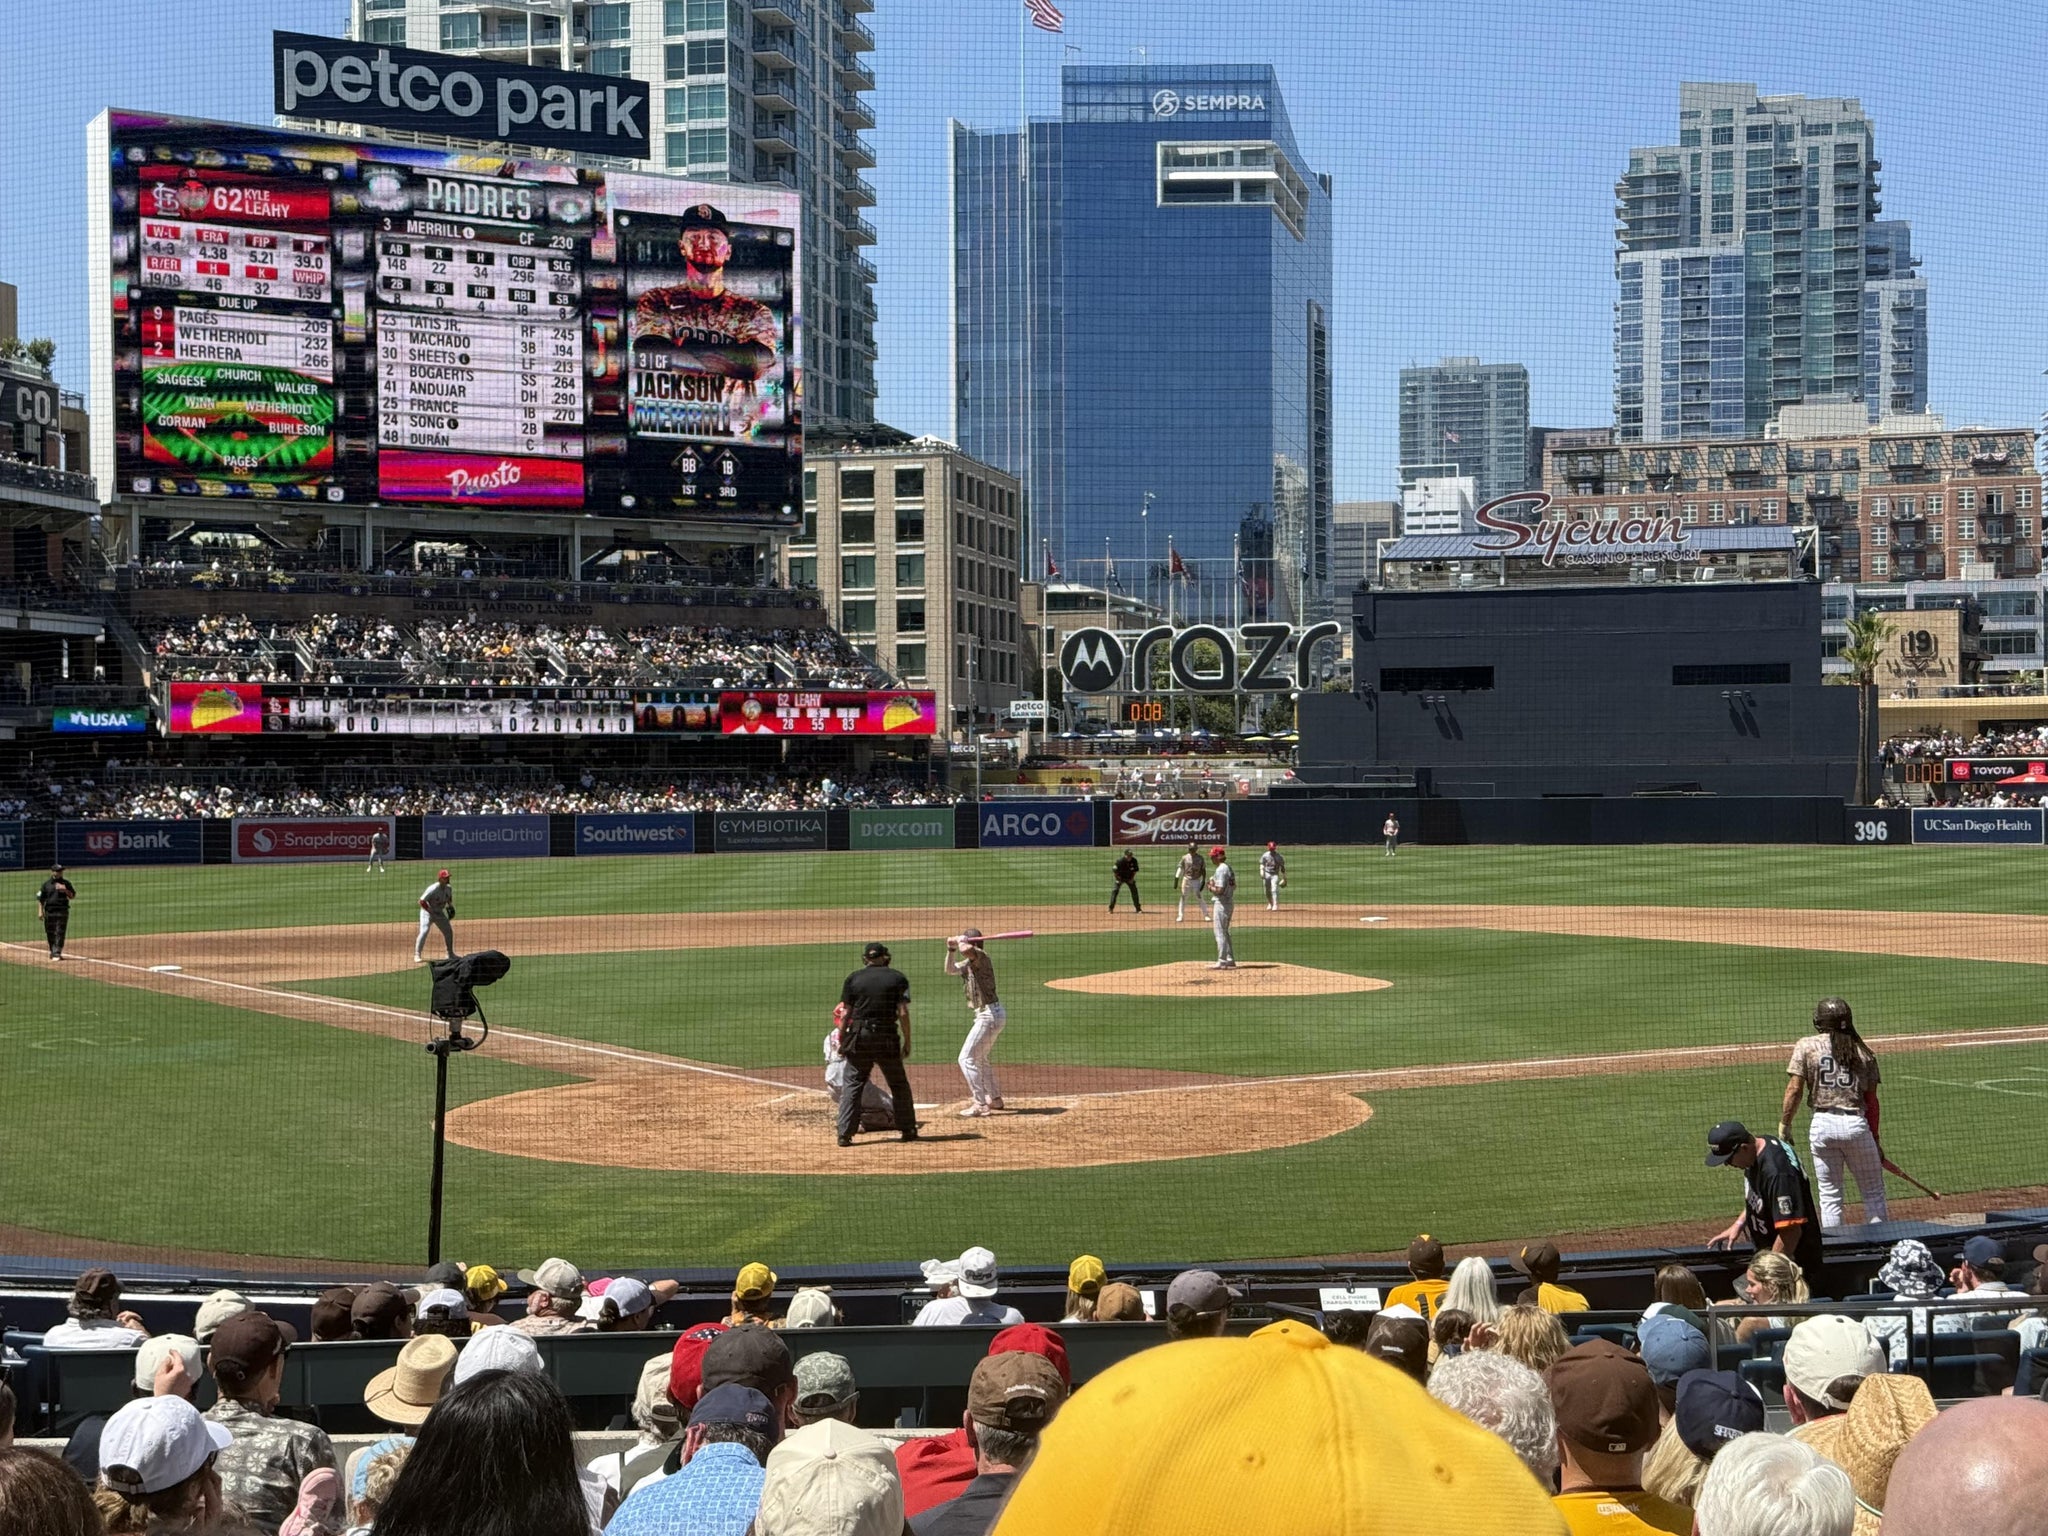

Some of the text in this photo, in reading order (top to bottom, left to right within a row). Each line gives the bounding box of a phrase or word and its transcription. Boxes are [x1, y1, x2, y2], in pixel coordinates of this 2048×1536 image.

[283, 49, 644, 139] petco park
[1184, 94, 1266, 111] SEMPRA
[213, 187, 243, 212] 62
[244, 188, 270, 201] KYLE
[427, 177, 532, 220] PADRES
[244, 200, 290, 218] LEAHY
[152, 226, 314, 252] W-L ERA FIP IP
[383, 217, 574, 250] 3 MERRILL CF .230
[199, 246, 228, 260] 4.38
[250, 251, 274, 264] 5.21
[294, 256, 323, 269] 39.0
[389, 244, 571, 272] AB R H OBP SLG
[150, 258, 323, 284] R/ER H K WHIP
[387, 257, 407, 271] 148
[432, 262, 447, 275] 22
[473, 266, 488, 279] 34
[509, 270, 535, 284] .296
[149, 272, 180, 287] 19/19
[205, 277, 222, 291] 46
[254, 282, 270, 295] 32
[390, 278, 569, 305] 2B 3B HR RBI SB
[218, 296, 258, 310] DUE UP
[436, 297, 444, 310] 0
[477, 301, 485, 313] 4
[516, 304, 529, 316] 18
[559, 307, 566, 320] 8
[153, 306, 328, 334] 9 PAGÉS .209
[381, 314, 575, 342] 23 TATIS JR. RF .245
[155, 324, 328, 350] 1 WETHERHOLT .232
[384, 331, 574, 357] 13 MACHADO 3B .194
[154, 342, 329, 367] 2 HERRERA .266
[382, 347, 574, 373] 30 SHEETS LF .213
[639, 353, 669, 369] 3 CF
[157, 374, 207, 388] SAGGESE
[216, 368, 262, 382] CHURCH
[386, 364, 575, 389] 2 BOGAERTS SS .264
[274, 381, 318, 395] WALKER
[383, 381, 576, 406] 41 ANDUJAR DH .290
[634, 372, 726, 403] JACKSON
[16, 386, 58, 427] CO.
[184, 395, 216, 410] WINN
[244, 401, 314, 415] WETHERHOLT
[383, 397, 575, 421] 25 FRANCE 1B .270
[158, 415, 206, 428] GORMAN
[269, 422, 325, 436] BURLESON
[383, 414, 537, 435] 24 SONG 2B
[635, 400, 735, 437] MERRILL
[383, 430, 534, 451] 48 DURÁN C
[223, 453, 258, 467] PAGÉS
[682, 458, 734, 475] BB 1B
[445, 461, 521, 499] Puesto
[682, 484, 737, 498] 1ST 3RD
[1471, 491, 1692, 567] Sycuan
[1565, 549, 1701, 565] CASINO RESORT
[482, 602, 534, 614] JALISCO
[538, 604, 593, 617] LANDING
[1132, 621, 1342, 693] razr
[794, 693, 822, 707] LEAHY
[1015, 702, 1044, 711] petco
[90, 713, 128, 727] USAA
[1130, 703, 1162, 721] 0:08
[371, 716, 539, 732] 0 0 2
[782, 718, 855, 731] 28 55 83
[1905, 763, 1944, 783] 0:08
[1973, 766, 2014, 775] TOYOTA
[583, 824, 675, 843] Southwest
[719, 819, 822, 833] CYMBIOTIKA
[982, 813, 1061, 837] ARCO
[1120, 805, 1217, 842] Sycuan
[1853, 820, 1888, 842] 396
[1923, 819, 2032, 834] UC San Diego Health
[87, 830, 172, 850] us bank
[453, 826, 547, 844] QuidelOrtho
